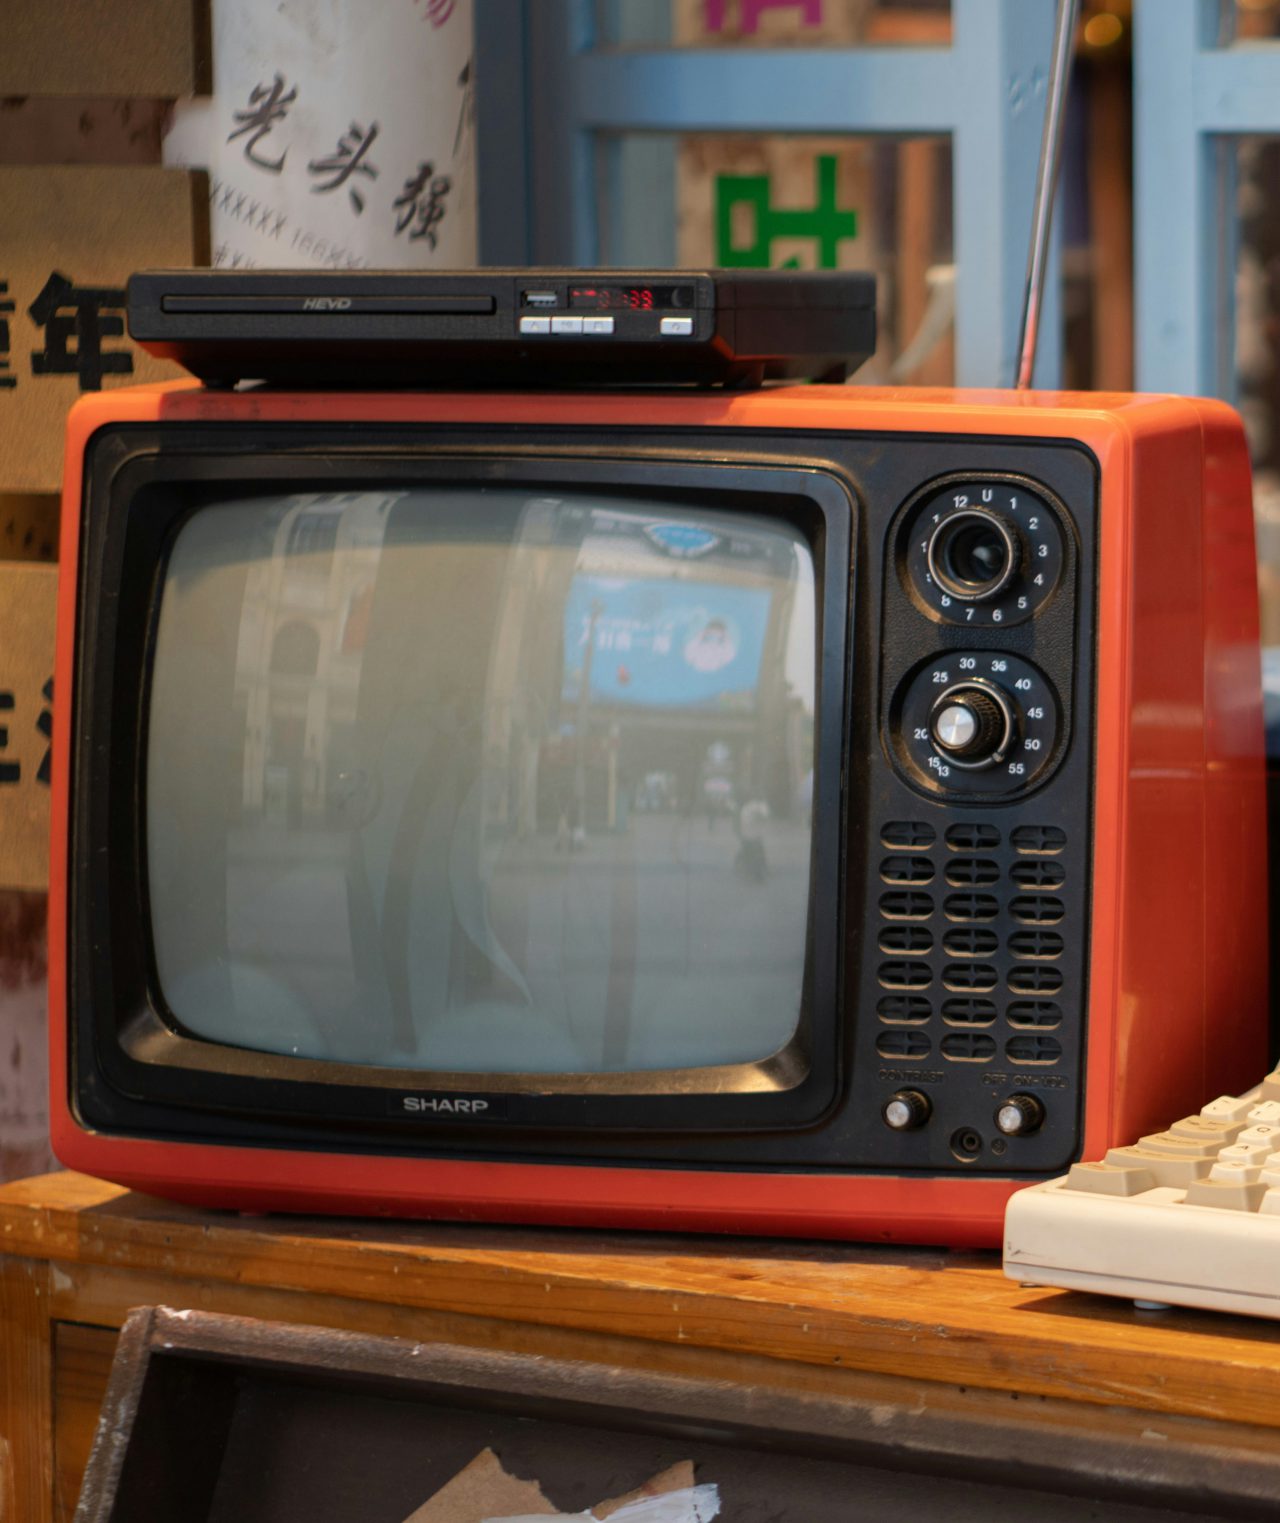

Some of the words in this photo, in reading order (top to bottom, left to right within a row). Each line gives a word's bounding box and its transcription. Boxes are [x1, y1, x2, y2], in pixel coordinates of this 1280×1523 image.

[953, 496, 968, 507] 12
[982, 489, 992, 502] U
[1009, 497, 1017, 509] 1
[1029, 517, 1038, 530] 2
[1038, 544, 1048, 557] 3
[1033, 573, 1044, 586] 4
[1018, 596, 1027, 609] 5
[965, 608, 974, 620] 7
[992, 609, 1002, 622] 6
[959, 658, 975, 670] 30
[932, 671, 948, 683] 25
[1015, 678, 1031, 690] 40
[1027, 706, 1043, 718] 45
[1024, 738, 1040, 750] 50
[928, 756, 940, 769] 15
[1008, 762, 1024, 774] 55
[937, 764, 949, 777] 13
[403, 1097, 489, 1114] SHARP
